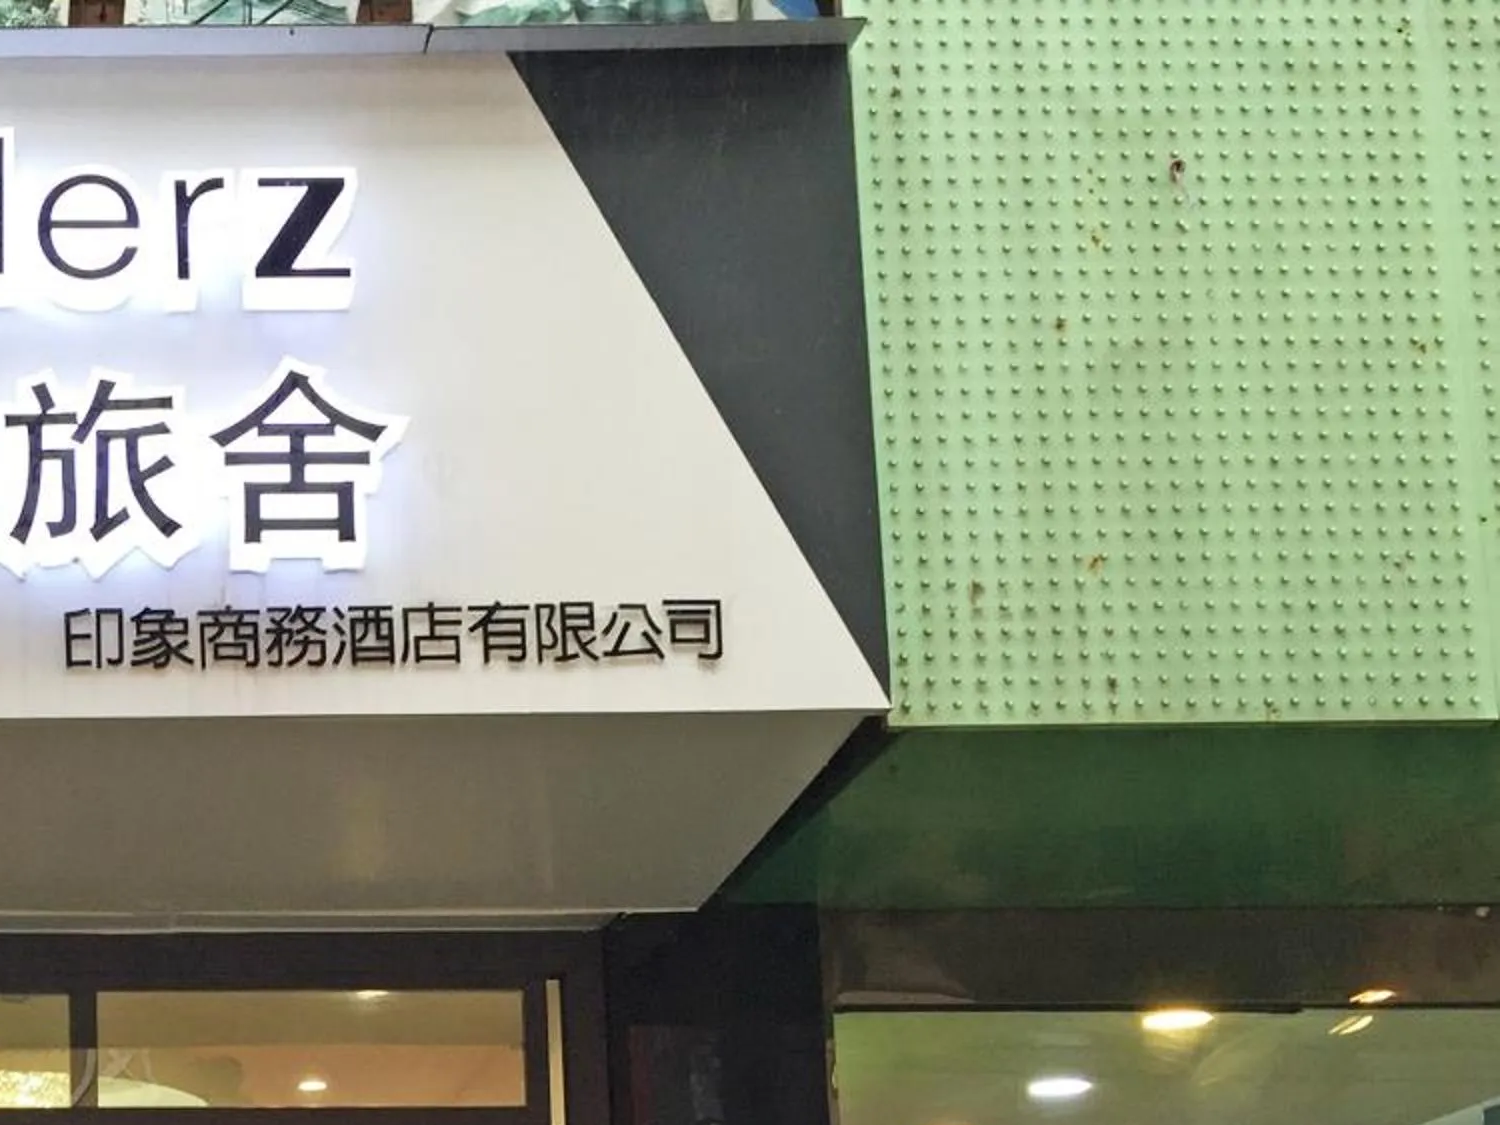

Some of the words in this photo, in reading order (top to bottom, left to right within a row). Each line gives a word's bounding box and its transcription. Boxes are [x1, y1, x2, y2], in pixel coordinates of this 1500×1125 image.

[63, 599, 725, 671] 印象商務酒店有限公司
